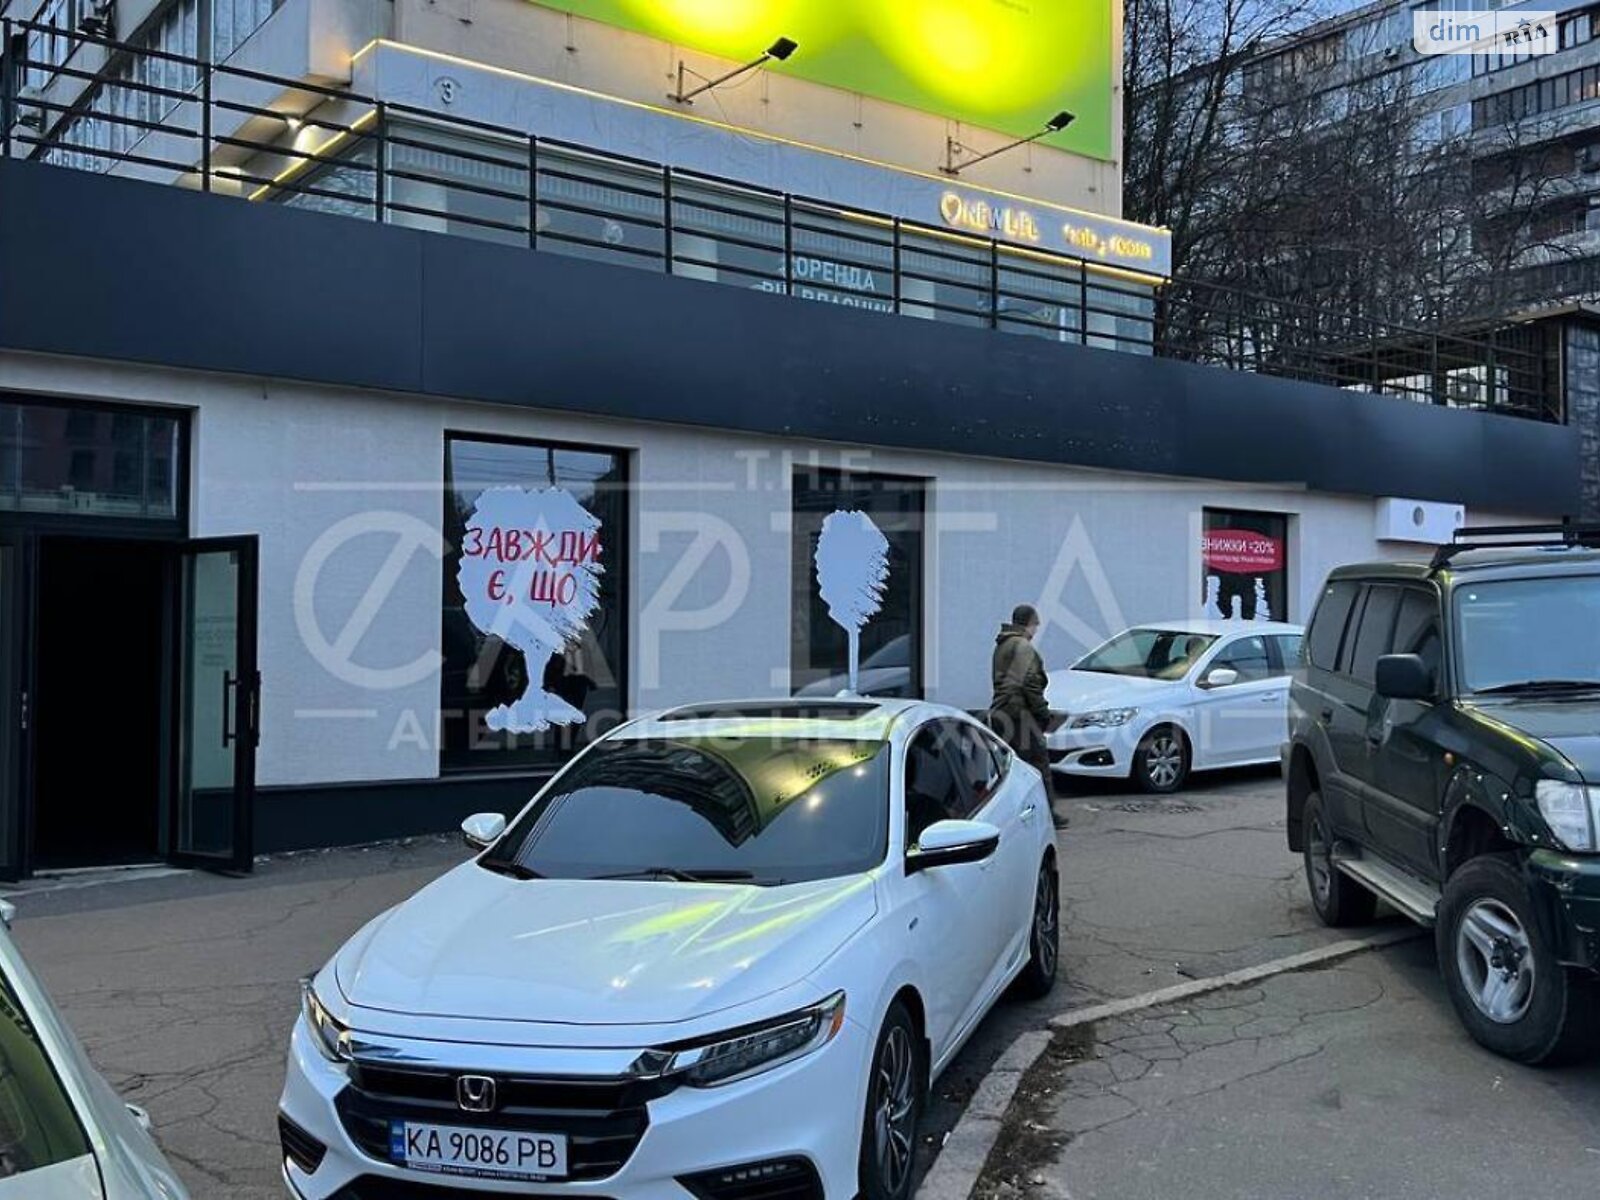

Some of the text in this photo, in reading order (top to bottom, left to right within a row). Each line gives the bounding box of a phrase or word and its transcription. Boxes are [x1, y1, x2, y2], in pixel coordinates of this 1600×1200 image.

[796, 257, 876, 291] ОРЕНДА
[464, 527, 602, 568] ЗАВЖДИ
[487, 570, 577, 608] Є, ЩО
[407, 1128, 557, 1169] KA 9086 PB
